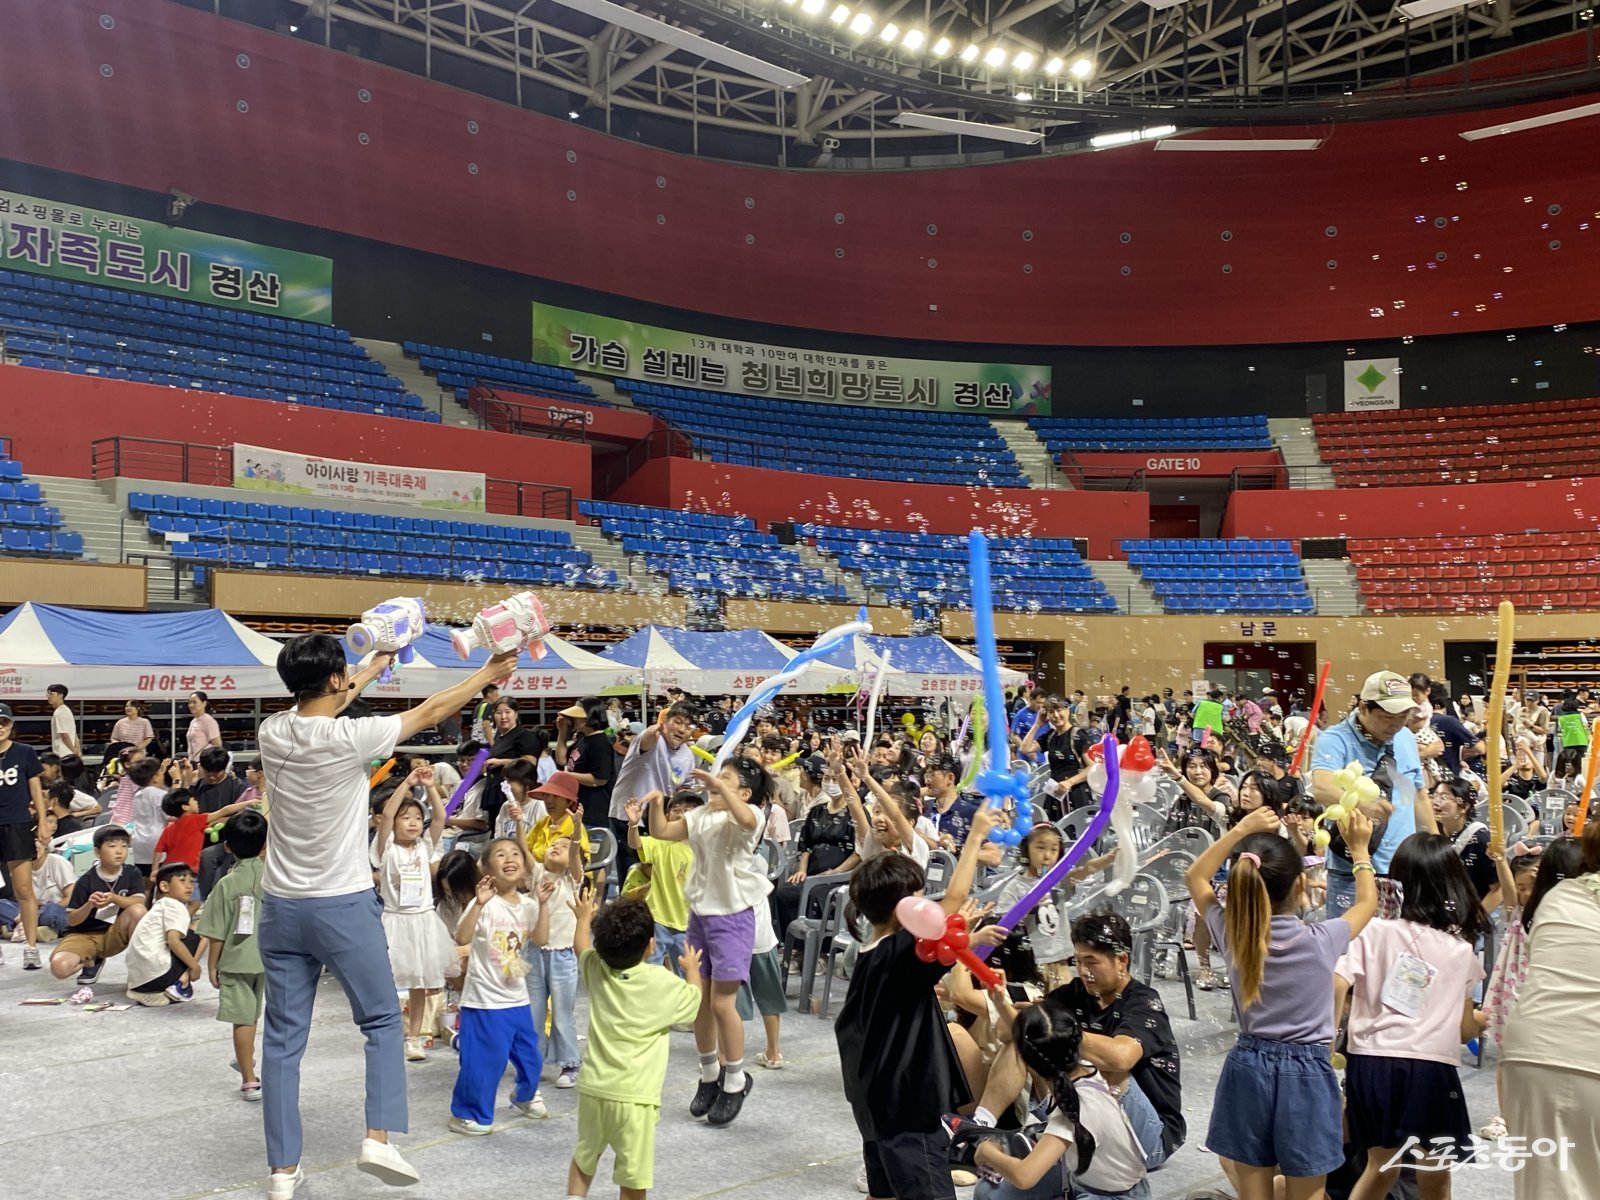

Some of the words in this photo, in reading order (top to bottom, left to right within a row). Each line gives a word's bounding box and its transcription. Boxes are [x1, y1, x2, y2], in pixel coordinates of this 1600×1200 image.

[91, 216, 141, 239] 누리는
[210, 263, 280, 306] 경산
[691, 338, 716, 352] 13개
[721, 342, 755, 357] 대학과
[761, 348, 798, 363] 10만여
[803, 353, 860, 369] 대학인재를
[570, 334, 627, 370] 가슴
[643, 348, 726, 384] 설레는
[741, 360, 937, 405] 청년희망도시
[953, 381, 1012, 408] 경산
[305, 463, 359, 483] 아이사랑
[1146, 458, 1184, 470] GATE
[1186, 457, 1201, 470] 10
[1240, 621, 1278, 636] 남문
[137, 675, 237, 691] 미아보호소
[733, 675, 798, 689] 소방스
